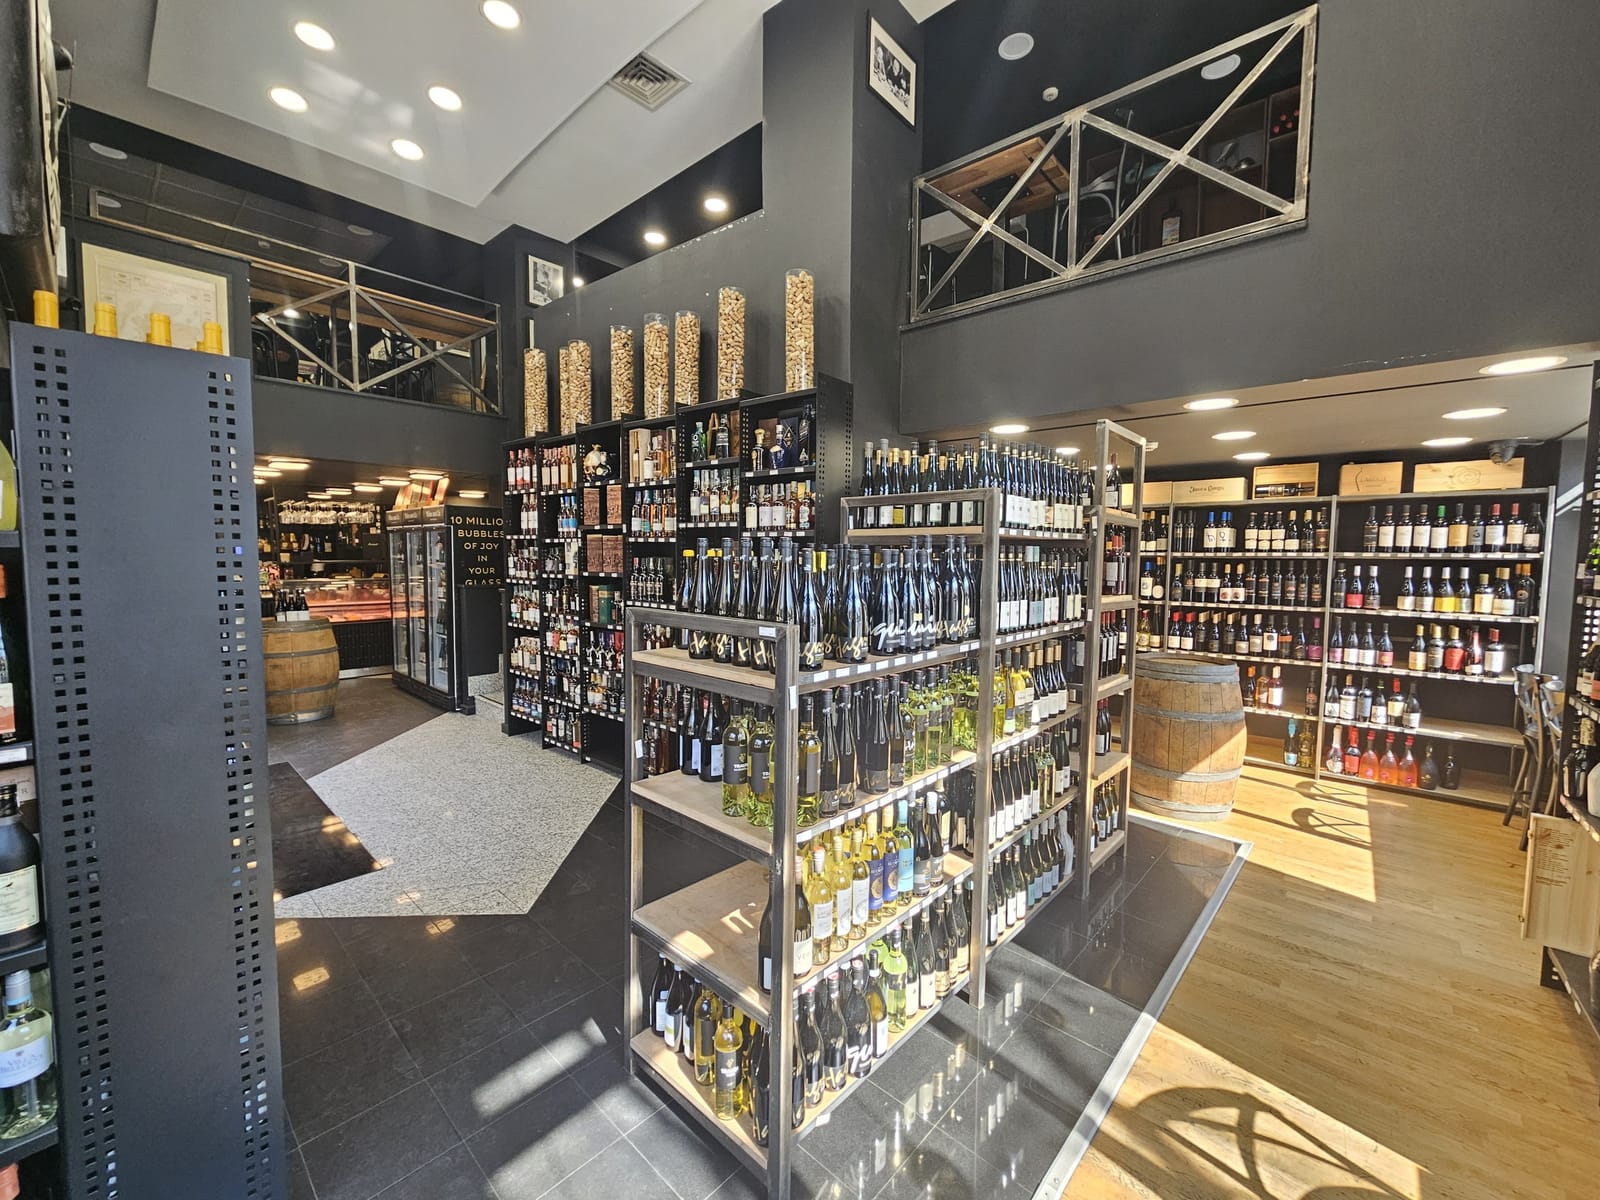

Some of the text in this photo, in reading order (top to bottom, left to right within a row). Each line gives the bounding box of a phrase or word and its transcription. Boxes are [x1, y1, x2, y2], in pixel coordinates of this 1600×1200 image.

[450, 516, 463, 525] 10
[466, 516, 503, 526] MILLIO
[457, 529, 504, 538] BUBBLES
[463, 542, 499, 550] OF JOY
